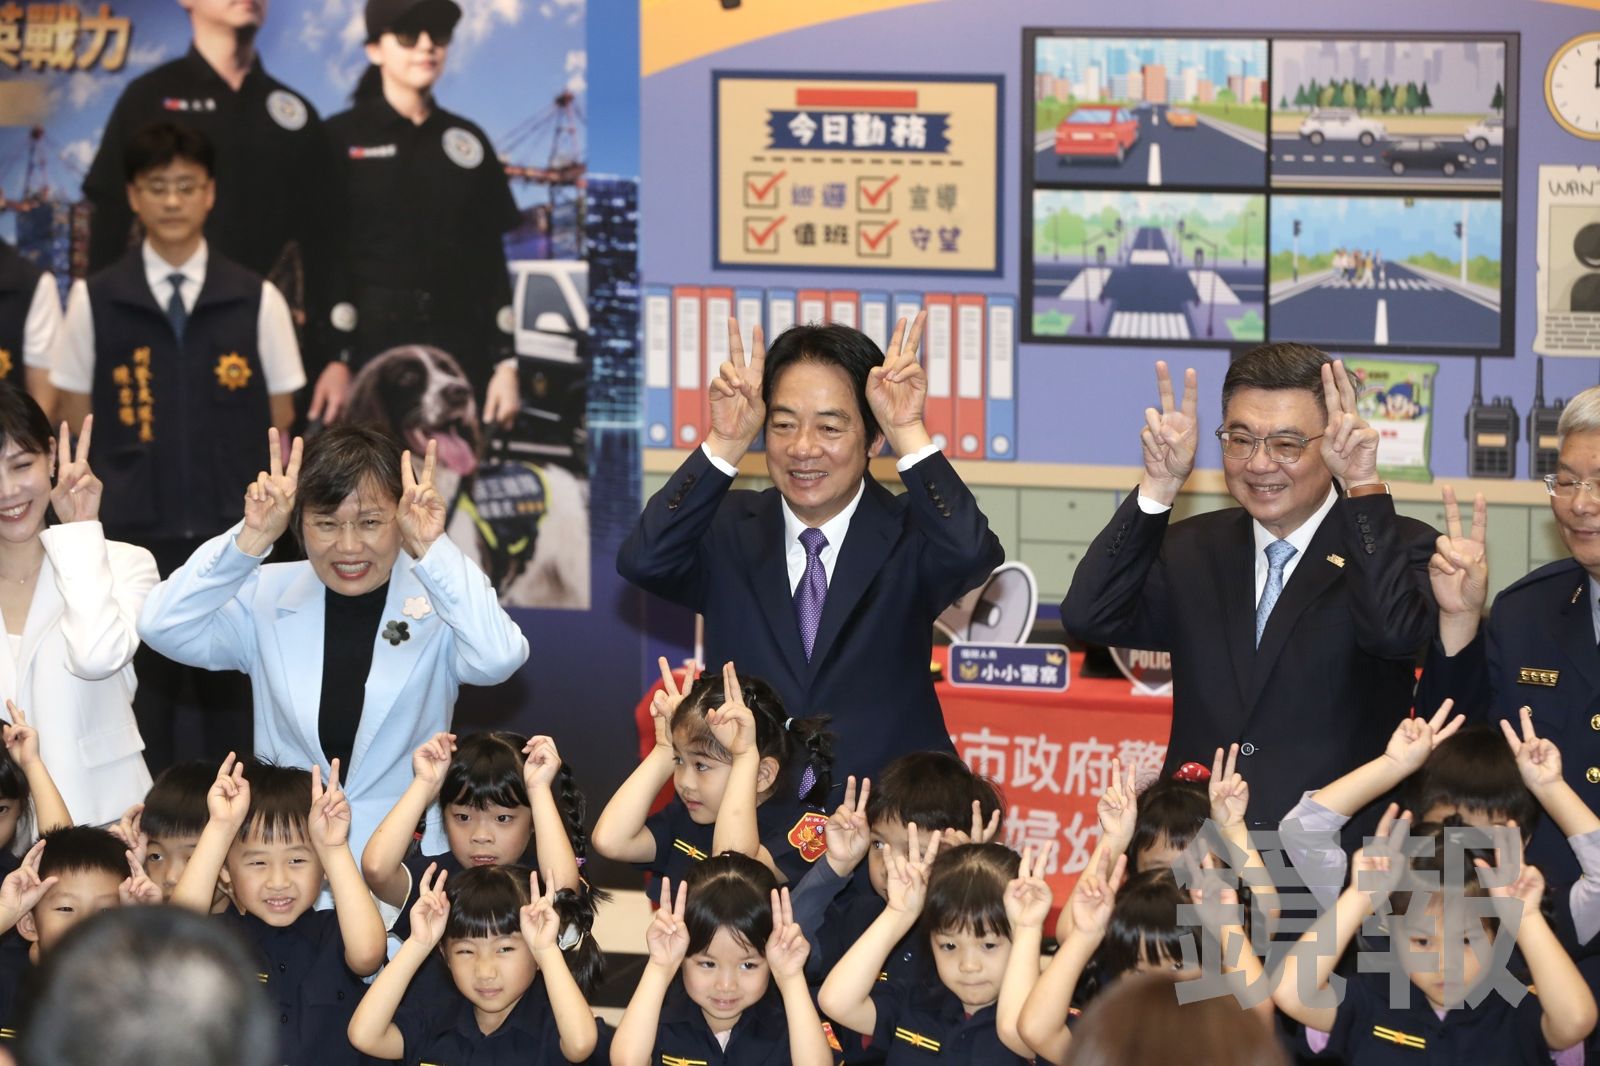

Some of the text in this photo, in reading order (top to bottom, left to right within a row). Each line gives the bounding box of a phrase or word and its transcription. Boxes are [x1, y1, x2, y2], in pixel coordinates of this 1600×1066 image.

[788, 111, 928, 149] 今日勤務
[793, 222, 849, 246] 值班
[910, 225, 961, 253] 守望
[980, 662, 1059, 685] 小小警察
